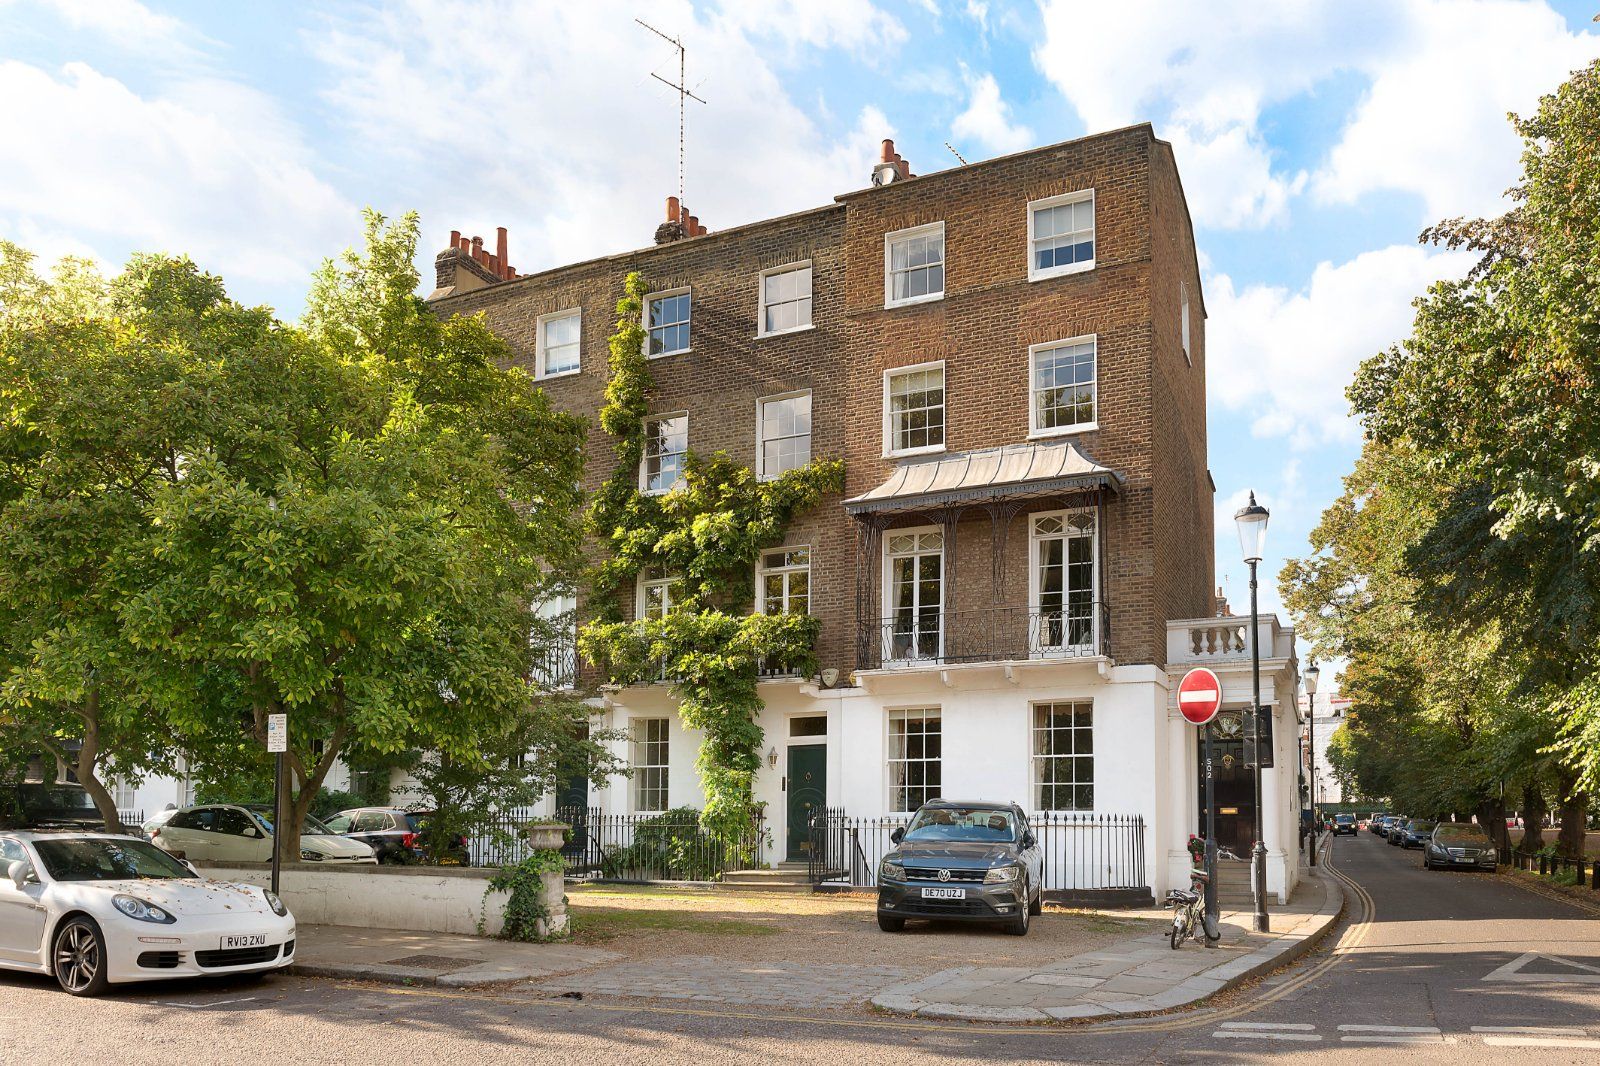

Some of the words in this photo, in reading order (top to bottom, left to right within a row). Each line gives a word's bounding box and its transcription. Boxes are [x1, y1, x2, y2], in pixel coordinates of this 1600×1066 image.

[925, 889, 945, 897] DE70
[947, 890, 962, 898] UZJ
[228, 937, 248, 947] RV13
[250, 935, 266, 946] ZXU
